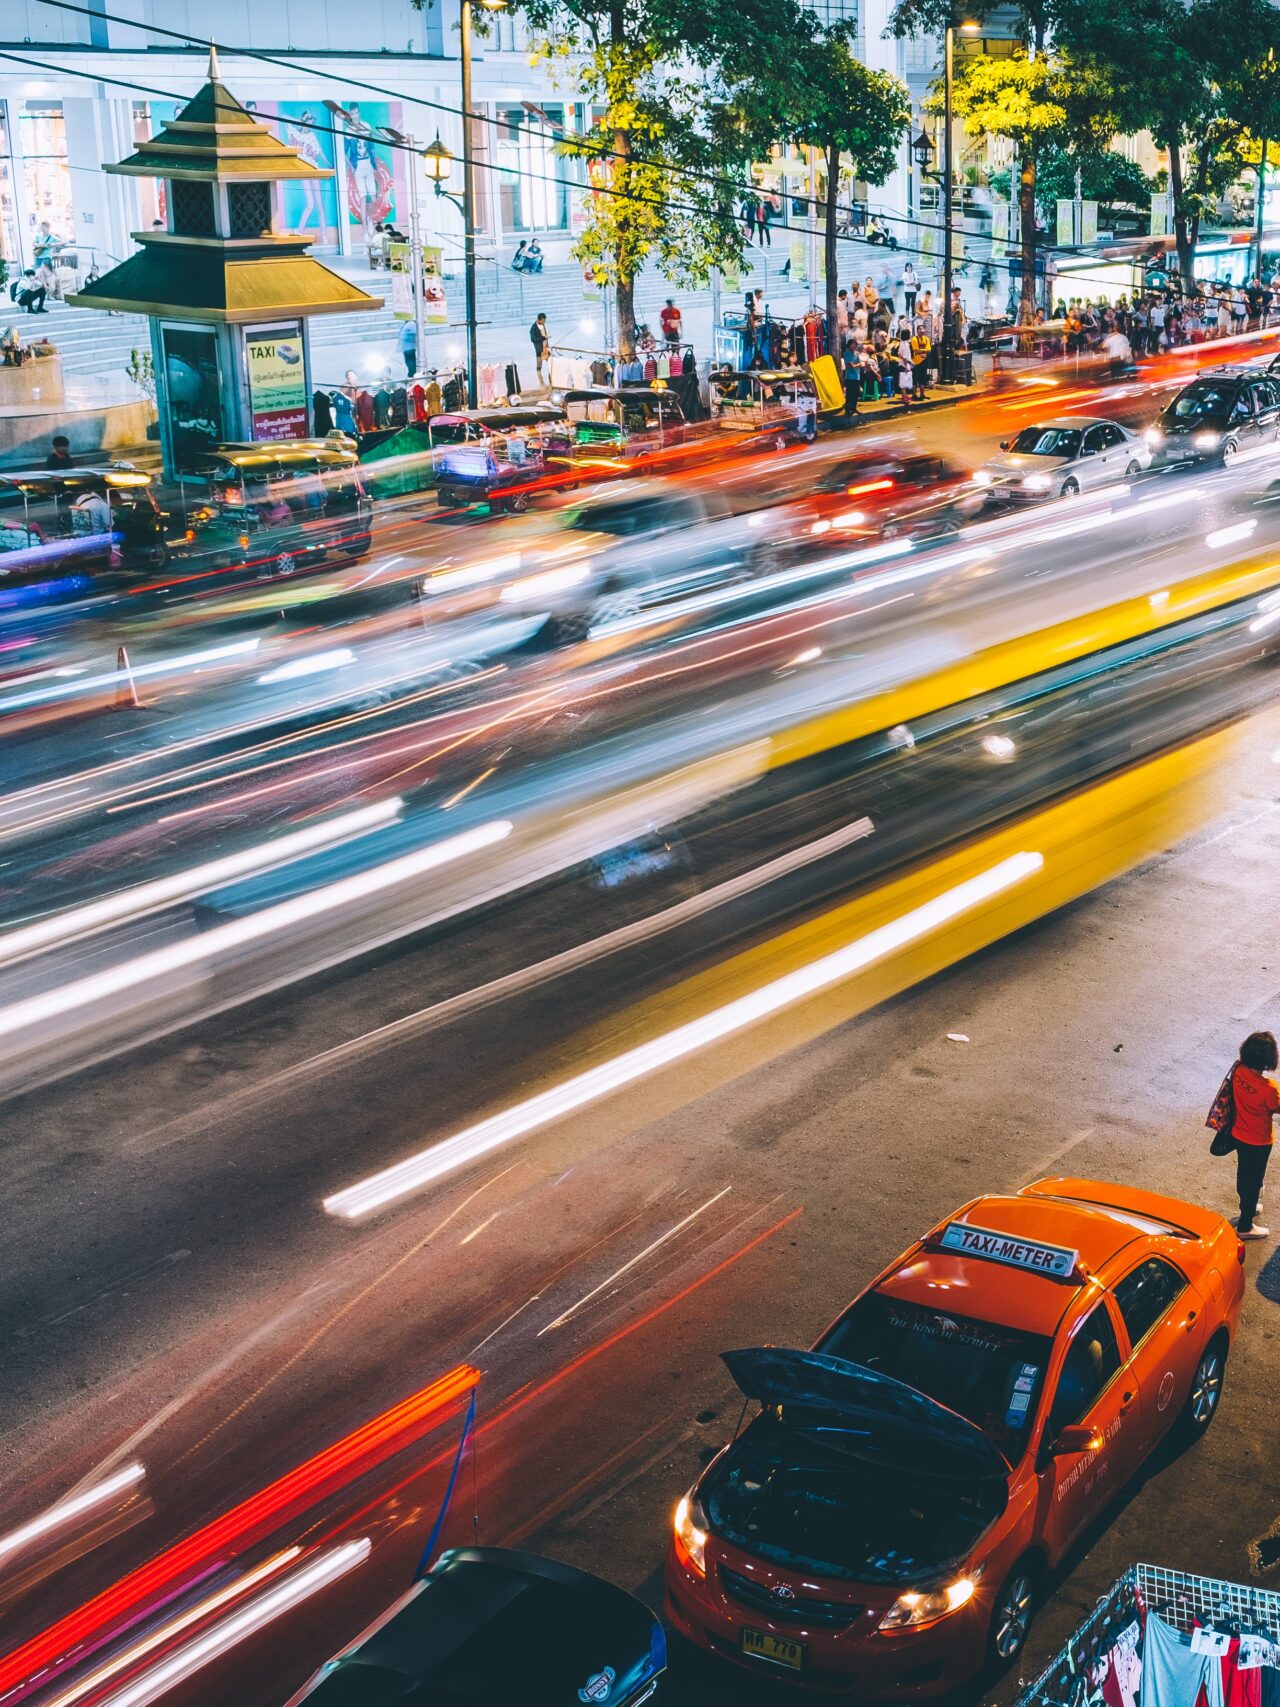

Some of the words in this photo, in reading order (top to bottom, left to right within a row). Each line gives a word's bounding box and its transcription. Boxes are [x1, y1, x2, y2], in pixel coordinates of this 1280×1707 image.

[250, 346, 275, 359] TAXI
[961, 1231, 1055, 1269] TAXI-METER
[888, 1316, 907, 1328] THE
[912, 1322, 938, 1335] KING
[959, 1334, 1000, 1352] STREET
[772, 1638, 797, 1658] 779
[586, 1675, 608, 1698] BOSSY
